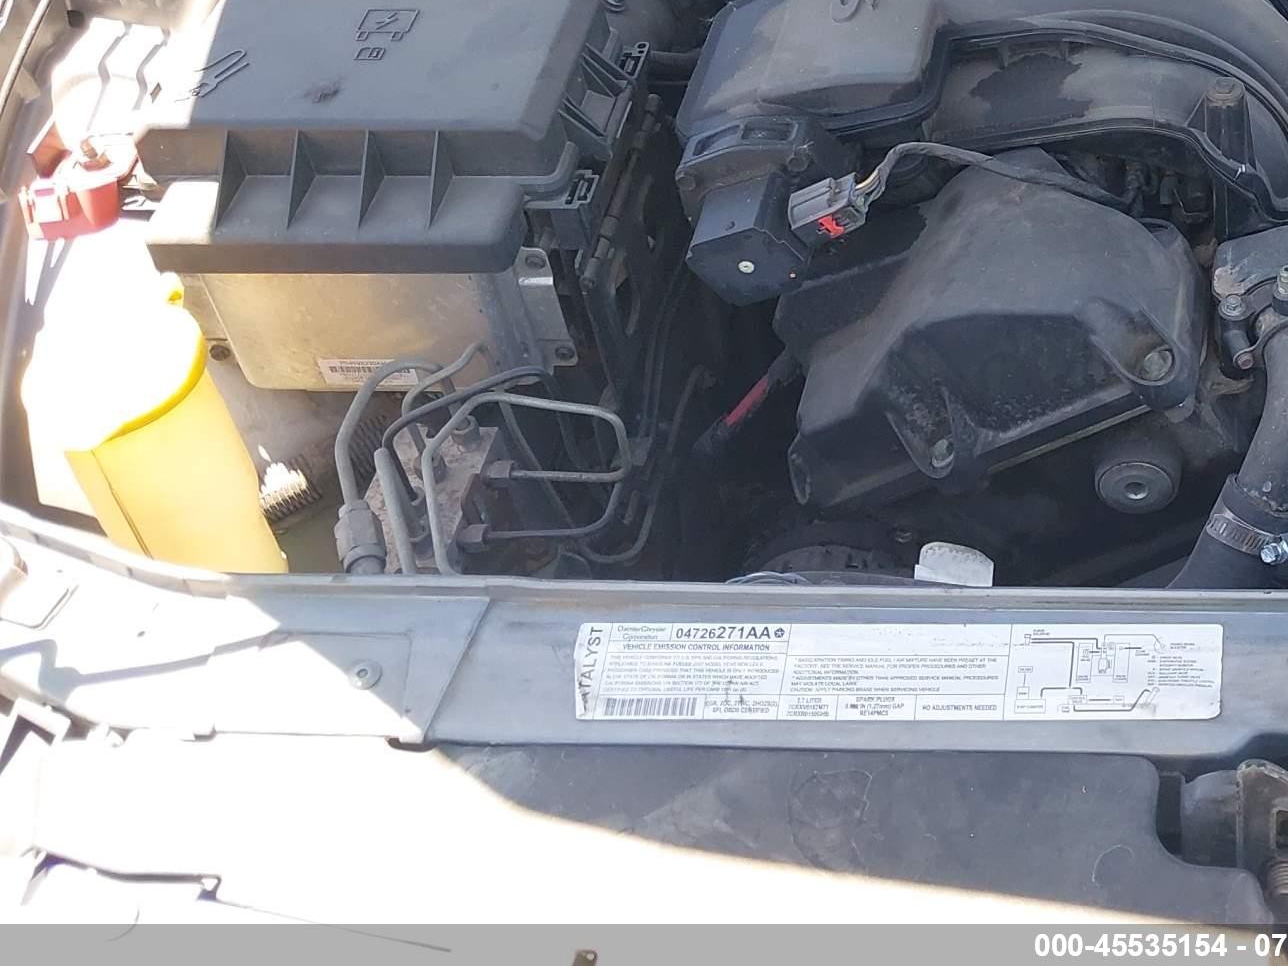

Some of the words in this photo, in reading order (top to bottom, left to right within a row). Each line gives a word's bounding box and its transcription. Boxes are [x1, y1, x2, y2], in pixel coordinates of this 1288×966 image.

[676, 626, 771, 639] 04726271AA
[624, 643, 652, 651] VEHICLE
[654, 643, 687, 651] EMISSION
[688, 643, 720, 651] CONTROL
[722, 643, 770, 651] INFORMATION
